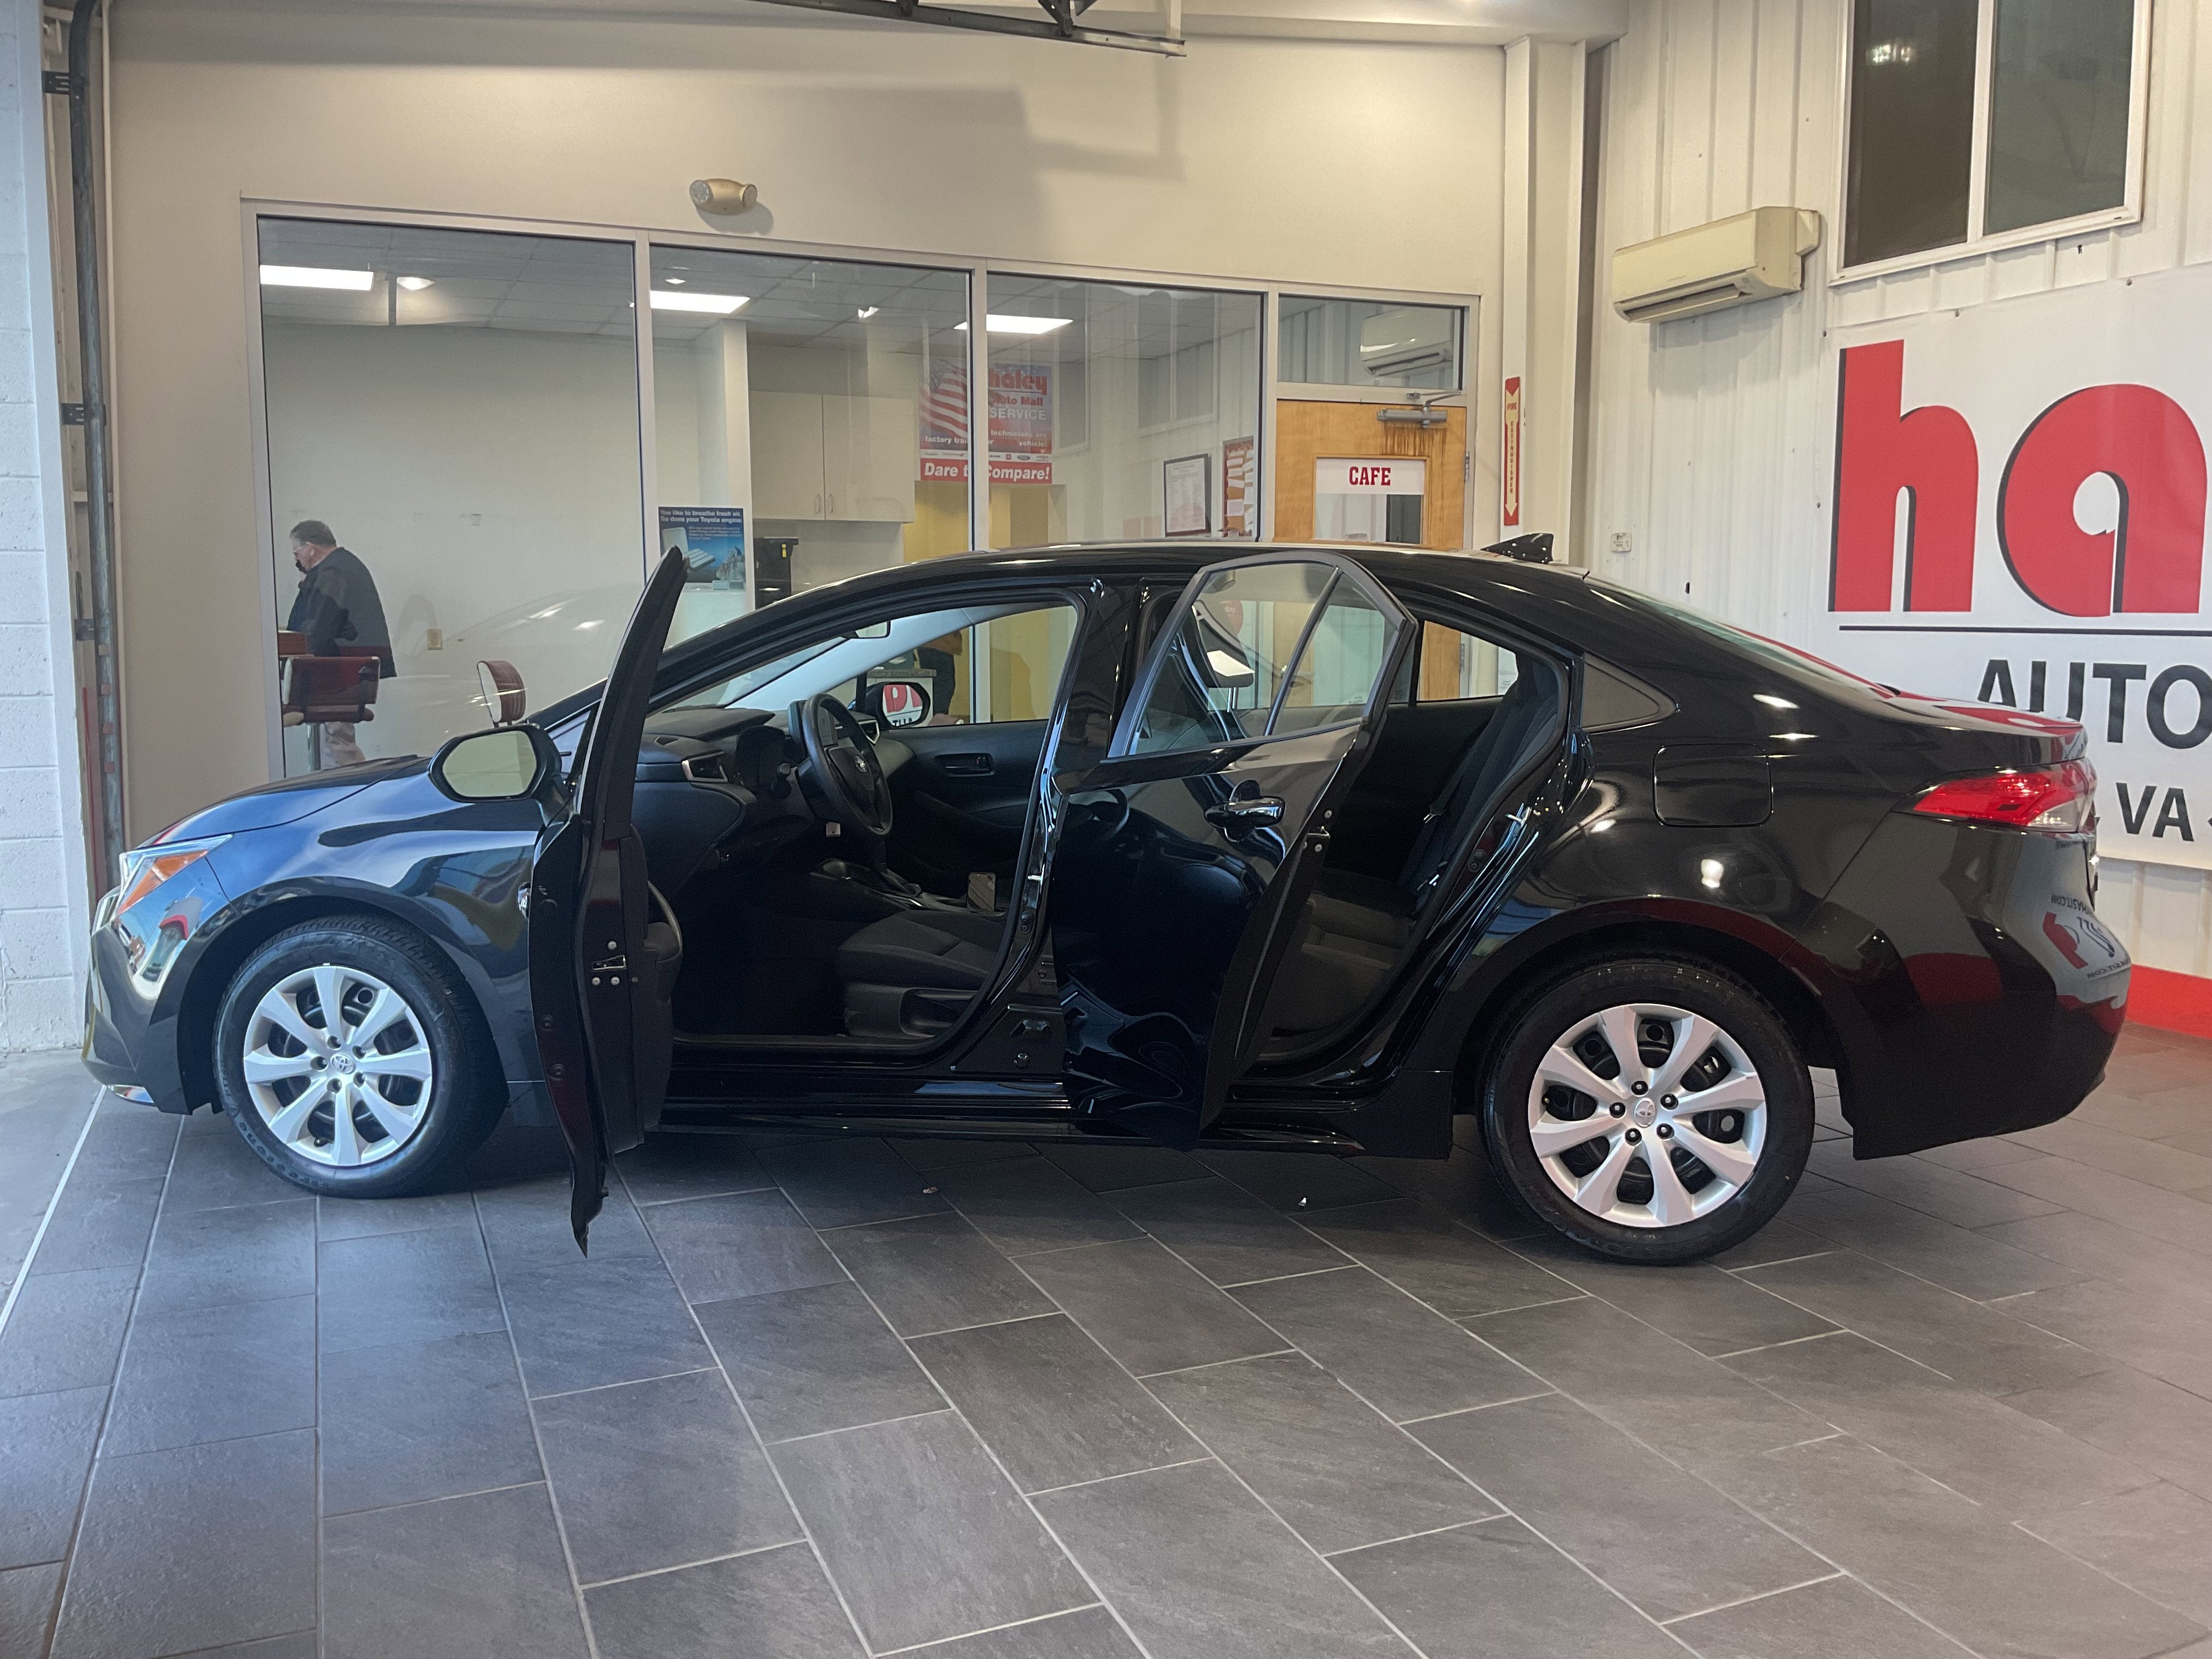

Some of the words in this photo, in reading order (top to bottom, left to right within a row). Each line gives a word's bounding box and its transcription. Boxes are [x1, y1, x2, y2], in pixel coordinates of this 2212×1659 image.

[988, 368, 1047, 395] haley
[1021, 396, 1043, 406] Mall
[1507, 402, 1517, 411] FIRE
[989, 407, 1047, 420] SERVICE
[925, 436, 952, 444] factory
[924, 462, 958, 477] Dare
[1349, 466, 1391, 486] CAFE
[1828, 338, 2208, 617] ha
[2116, 782, 2195, 842] VA
